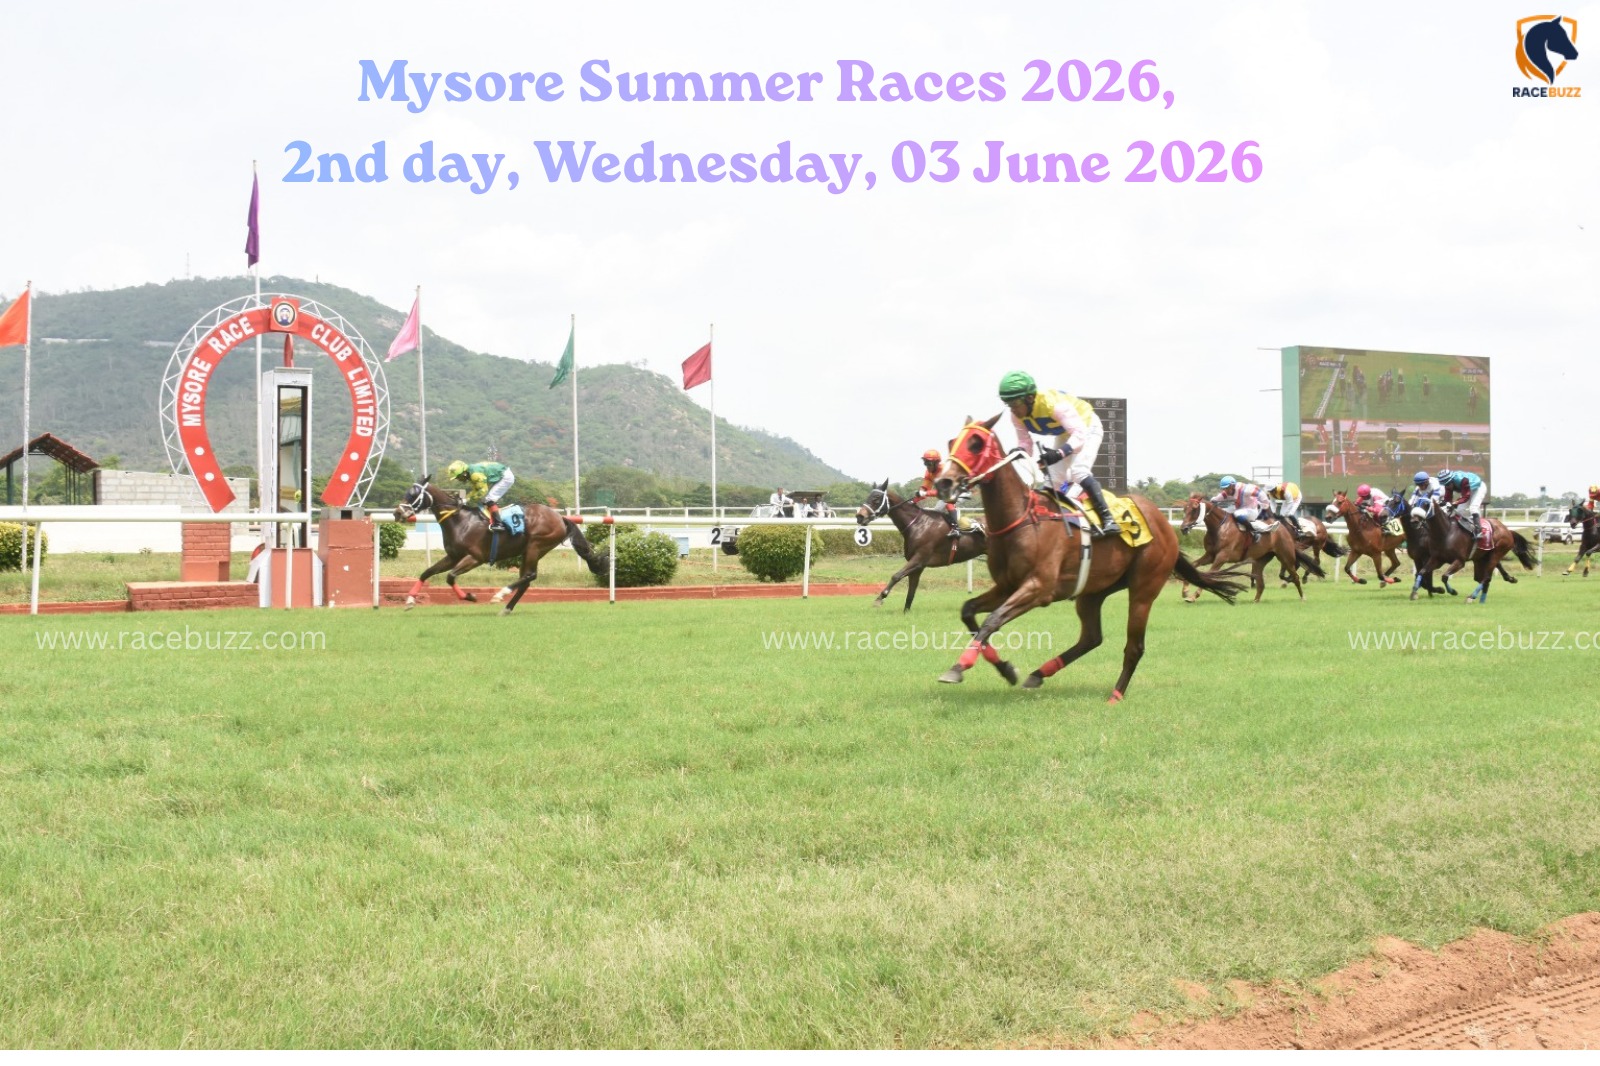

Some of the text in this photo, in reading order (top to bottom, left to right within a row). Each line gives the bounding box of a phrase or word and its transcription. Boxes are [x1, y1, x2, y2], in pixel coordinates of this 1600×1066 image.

[182, 317, 375, 438] MYSORE RACE CLUB LIMITED
[511, 513, 521, 529] 9
[711, 528, 722, 545] 2
[858, 528, 868, 545] 3
